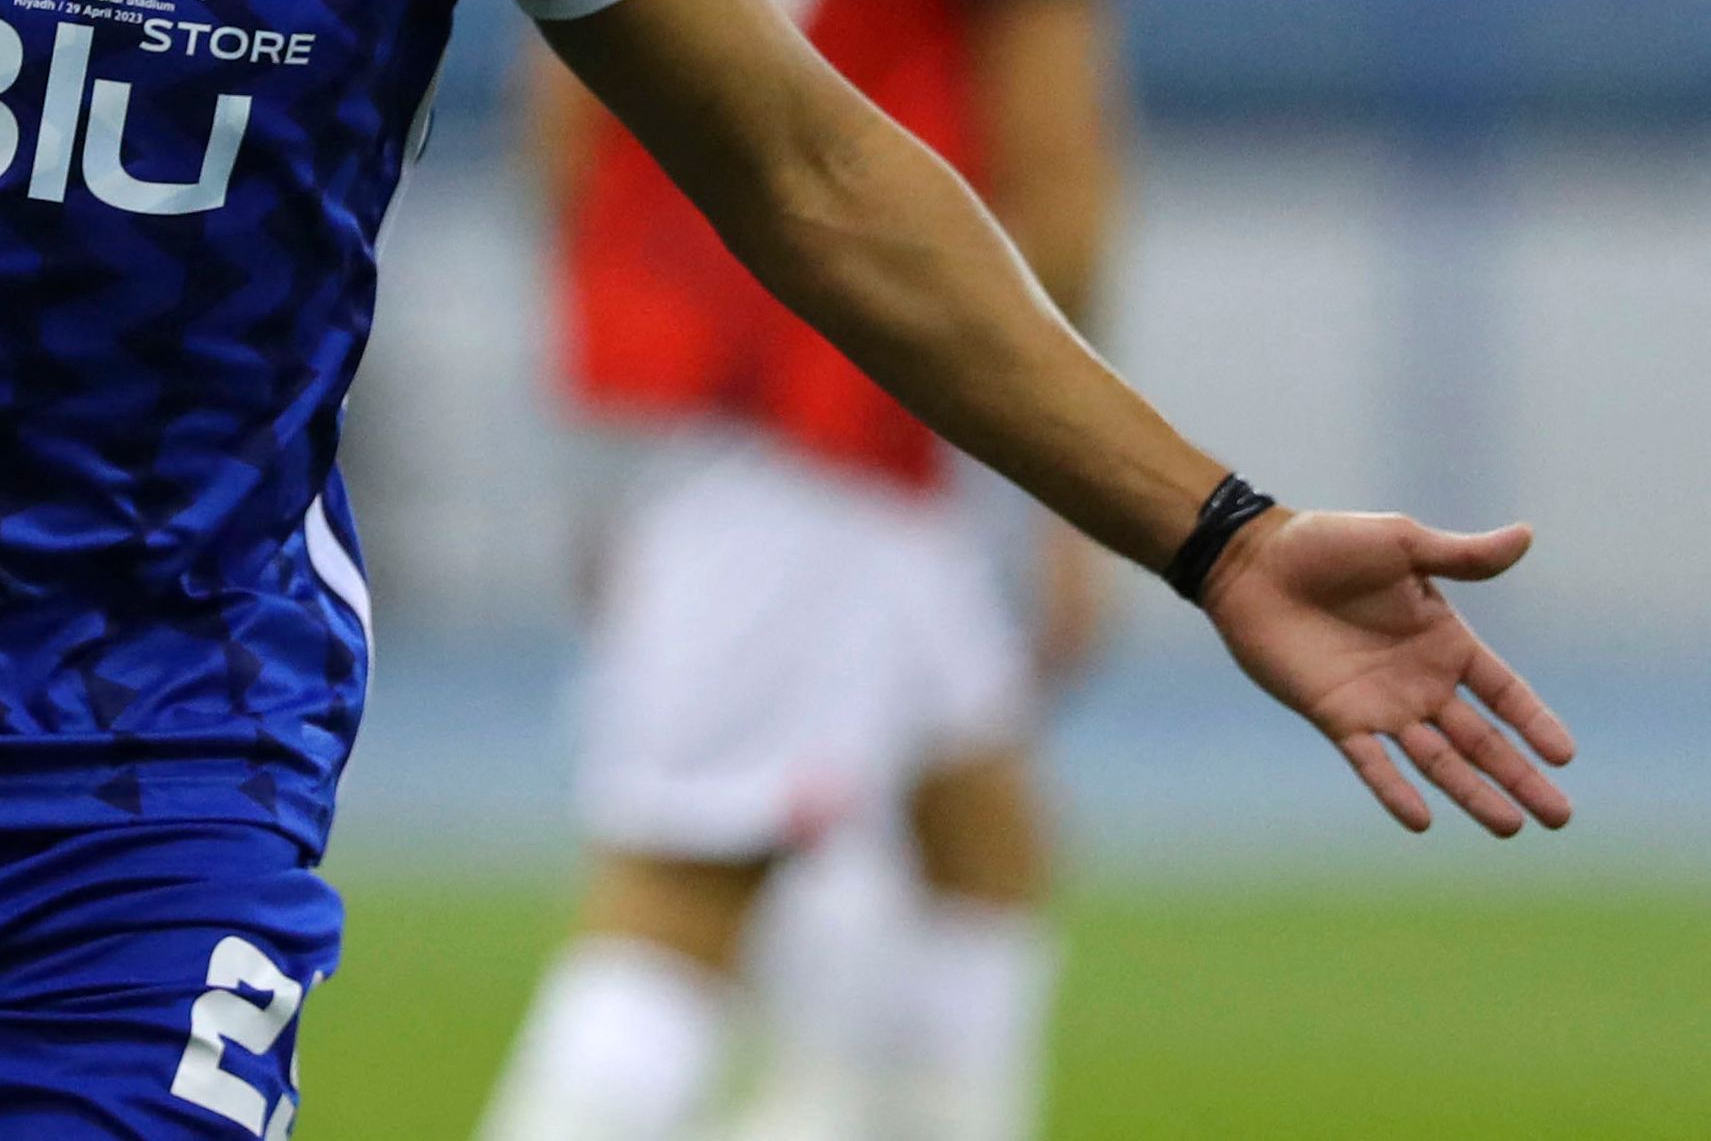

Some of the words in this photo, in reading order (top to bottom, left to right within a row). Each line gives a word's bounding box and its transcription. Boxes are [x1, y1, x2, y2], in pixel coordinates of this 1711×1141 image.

[67, 1, 81, 14] 29
[83, 5, 112, 22] April
[114, 10, 143, 25] 2023
[139, 16, 316, 65] STORE
[170, 935, 324, 1141] 2
